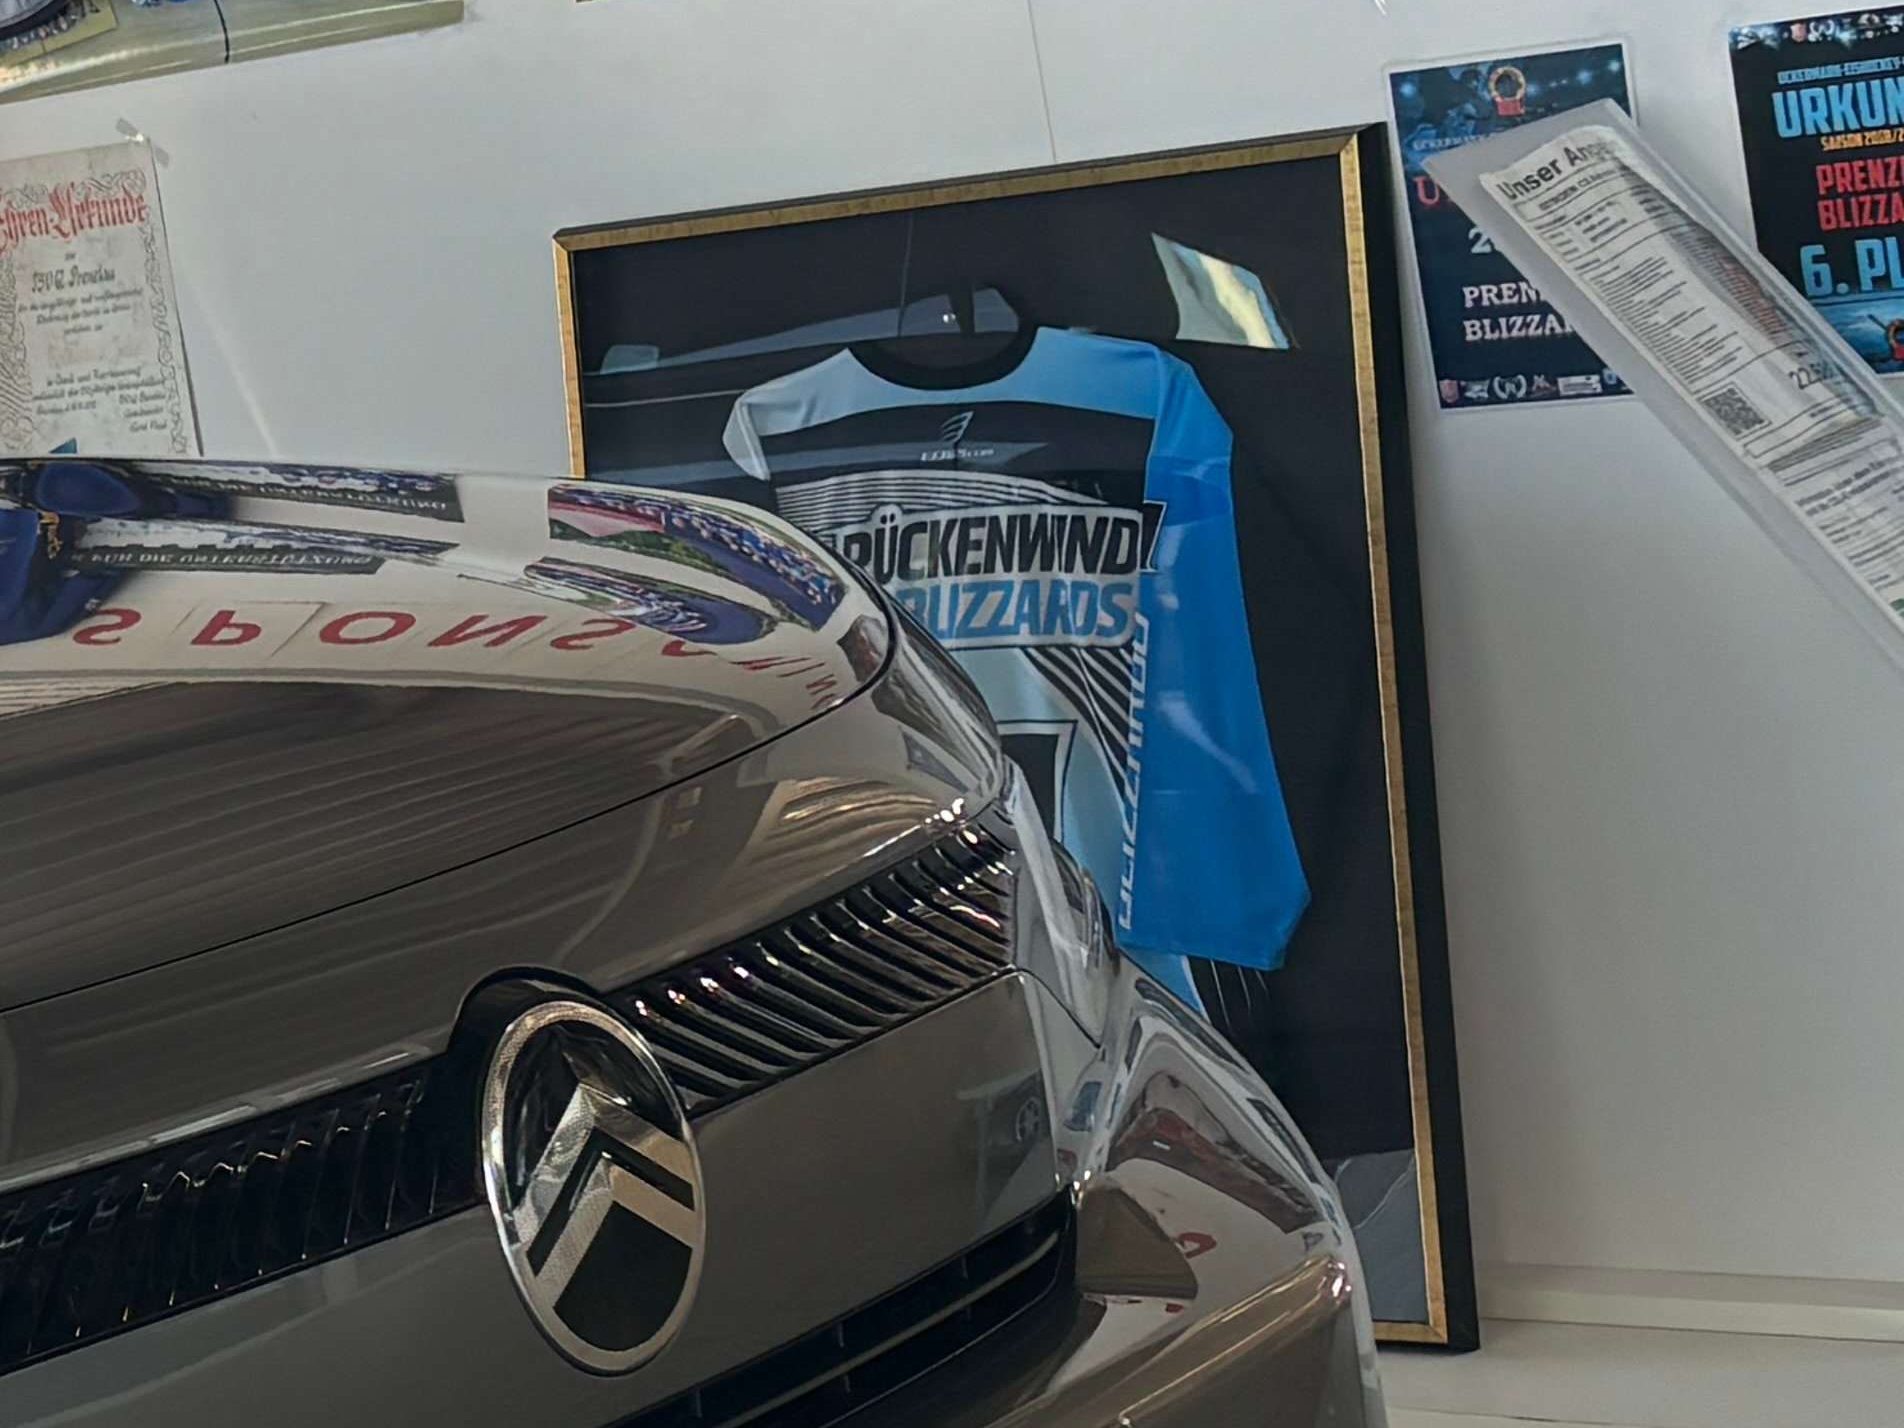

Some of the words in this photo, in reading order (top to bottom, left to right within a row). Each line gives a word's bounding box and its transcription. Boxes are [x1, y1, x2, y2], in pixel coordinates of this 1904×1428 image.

[1496, 157, 1563, 202] Unser
[1799, 243, 1850, 297] 6.
[1462, 281, 1542, 308] PREN
[1463, 313, 1576, 342] BLIZZA
